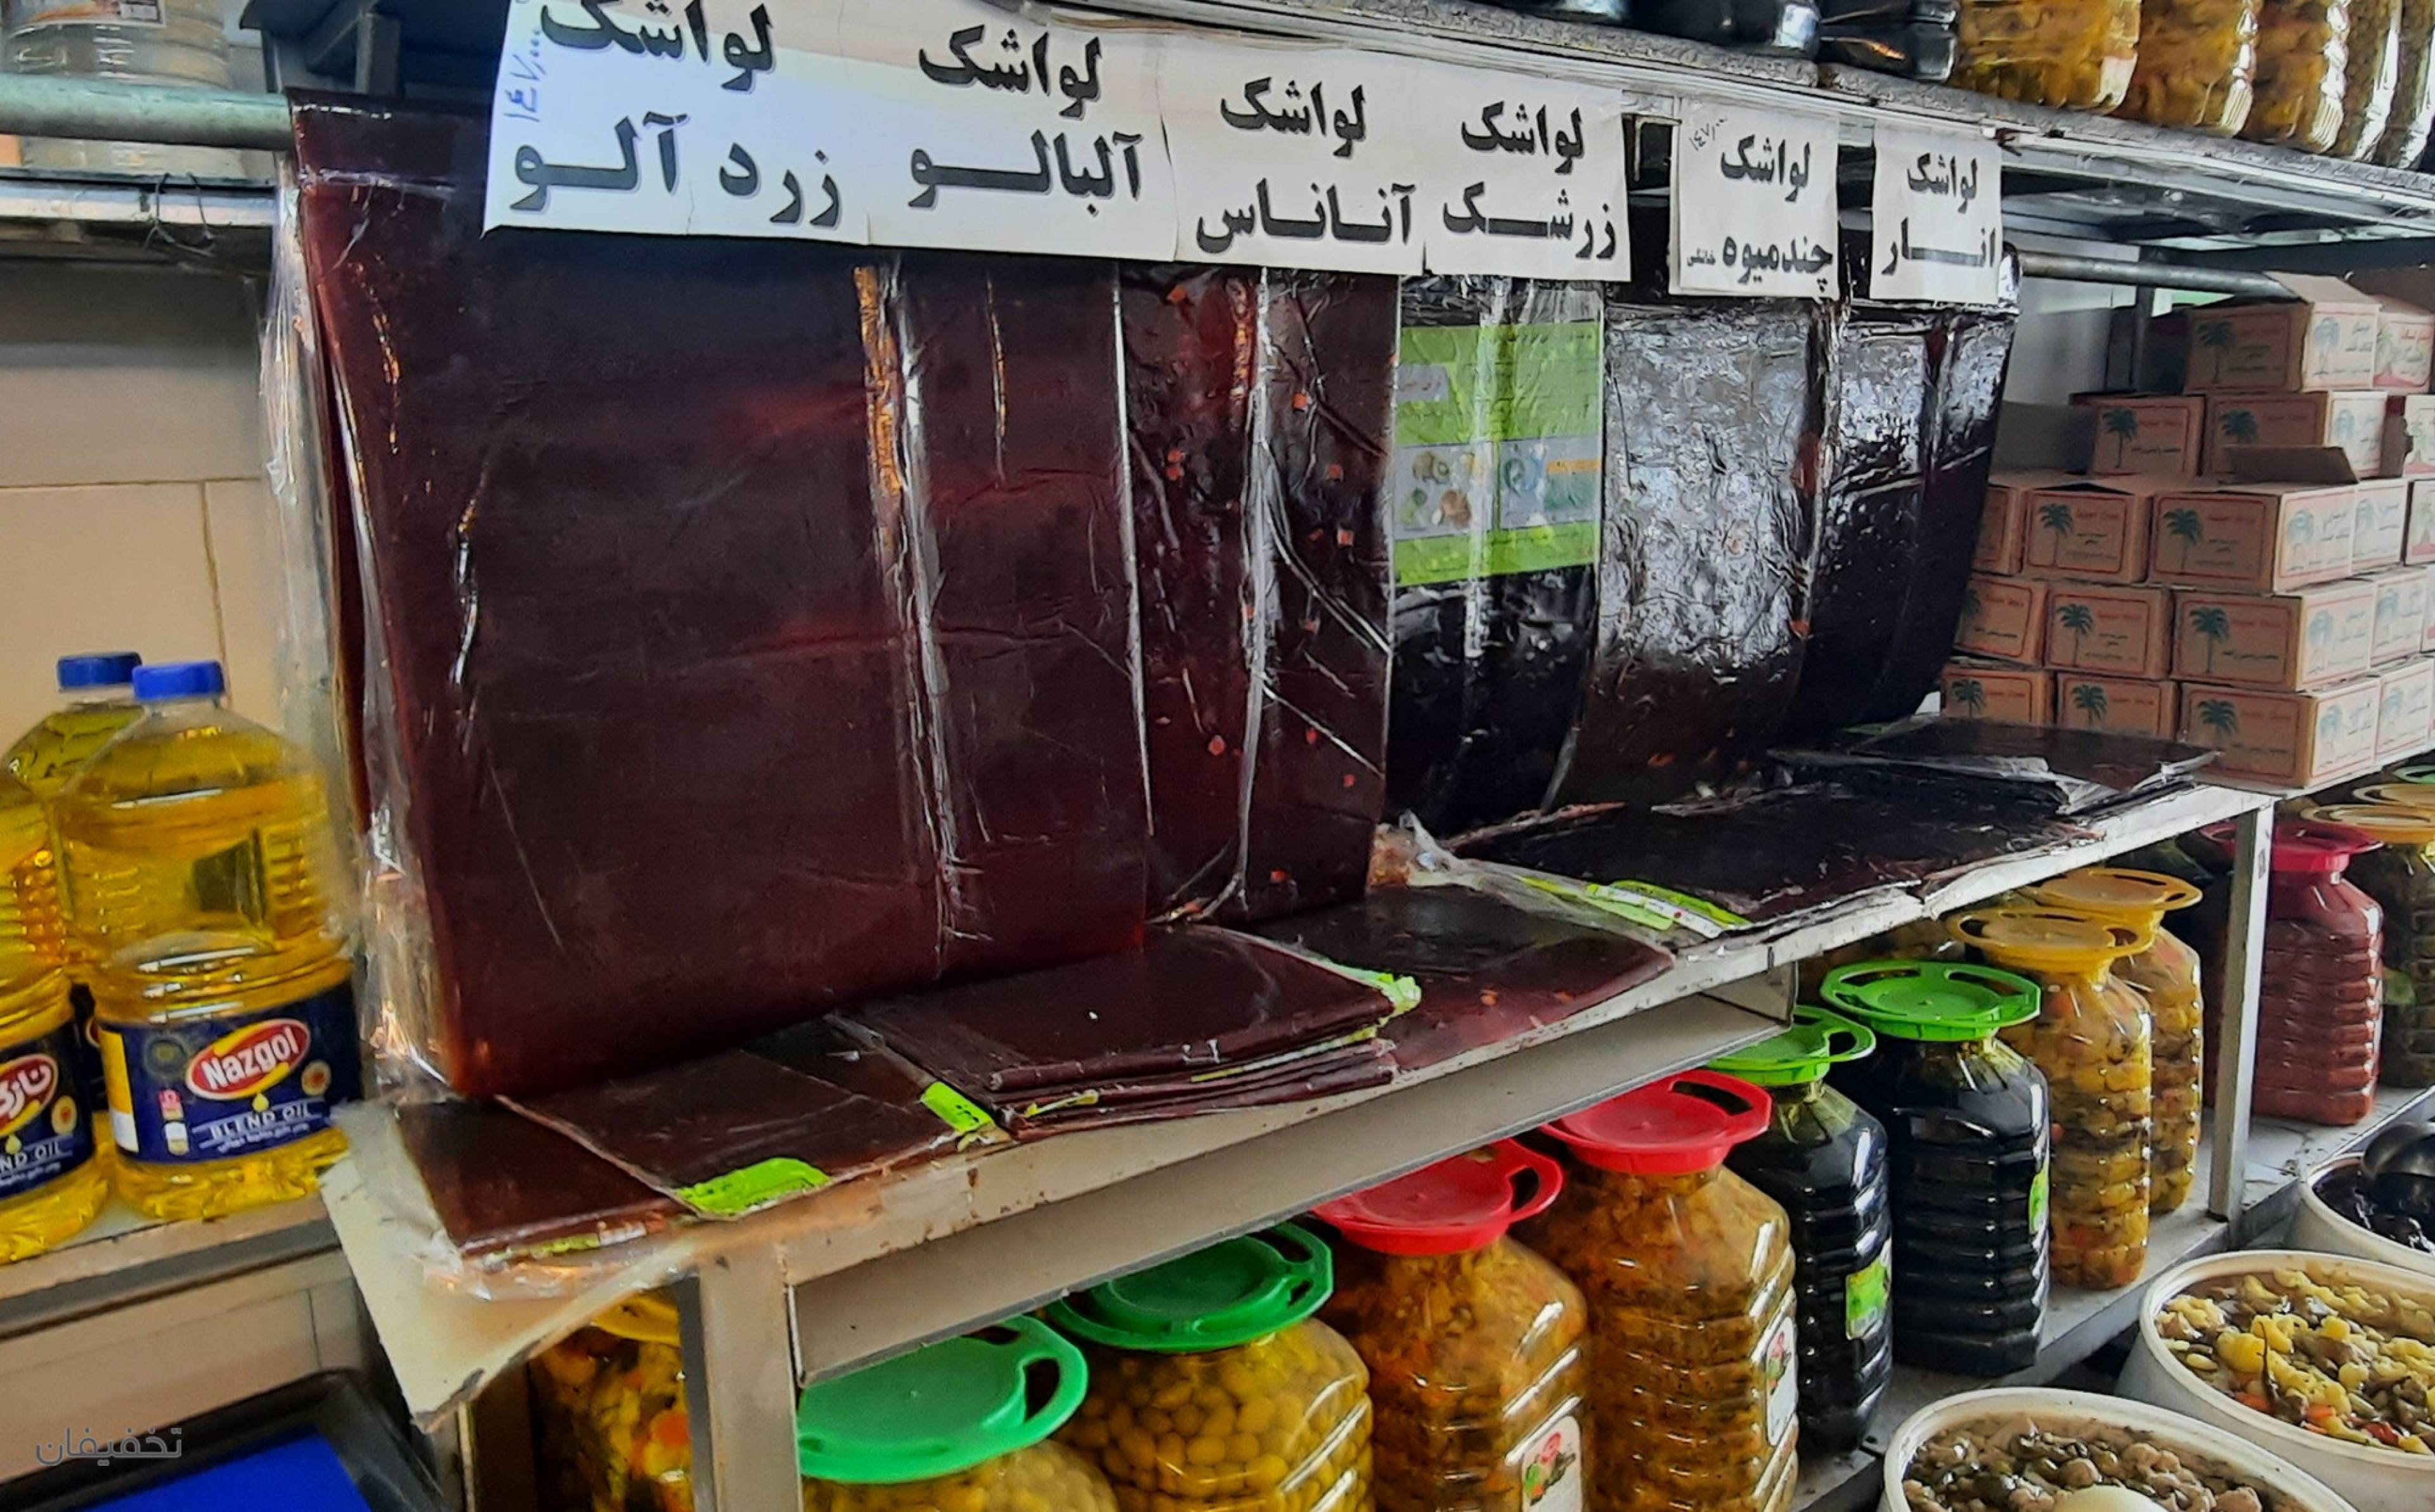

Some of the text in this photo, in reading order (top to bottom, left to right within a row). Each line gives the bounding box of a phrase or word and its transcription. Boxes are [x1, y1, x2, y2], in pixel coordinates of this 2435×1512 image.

[540, 0, 775, 92] لواشک
[919, 24, 1102, 120] لواشک
[1220, 77, 1367, 157] لواشک
[1461, 101, 1585, 173] لواشک
[509, 112, 840, 228] زرد آلو
[908, 129, 1142, 217] آلبالو
[1720, 134, 1810, 202] لواشک
[1906, 152, 1978, 214] لواشک
[1197, 178, 1416, 253] آناناس
[1442, 181, 1616, 261] زرشک
[1881, 217, 1996, 275] انار
[201, 1026, 300, 1090] Nazgol
